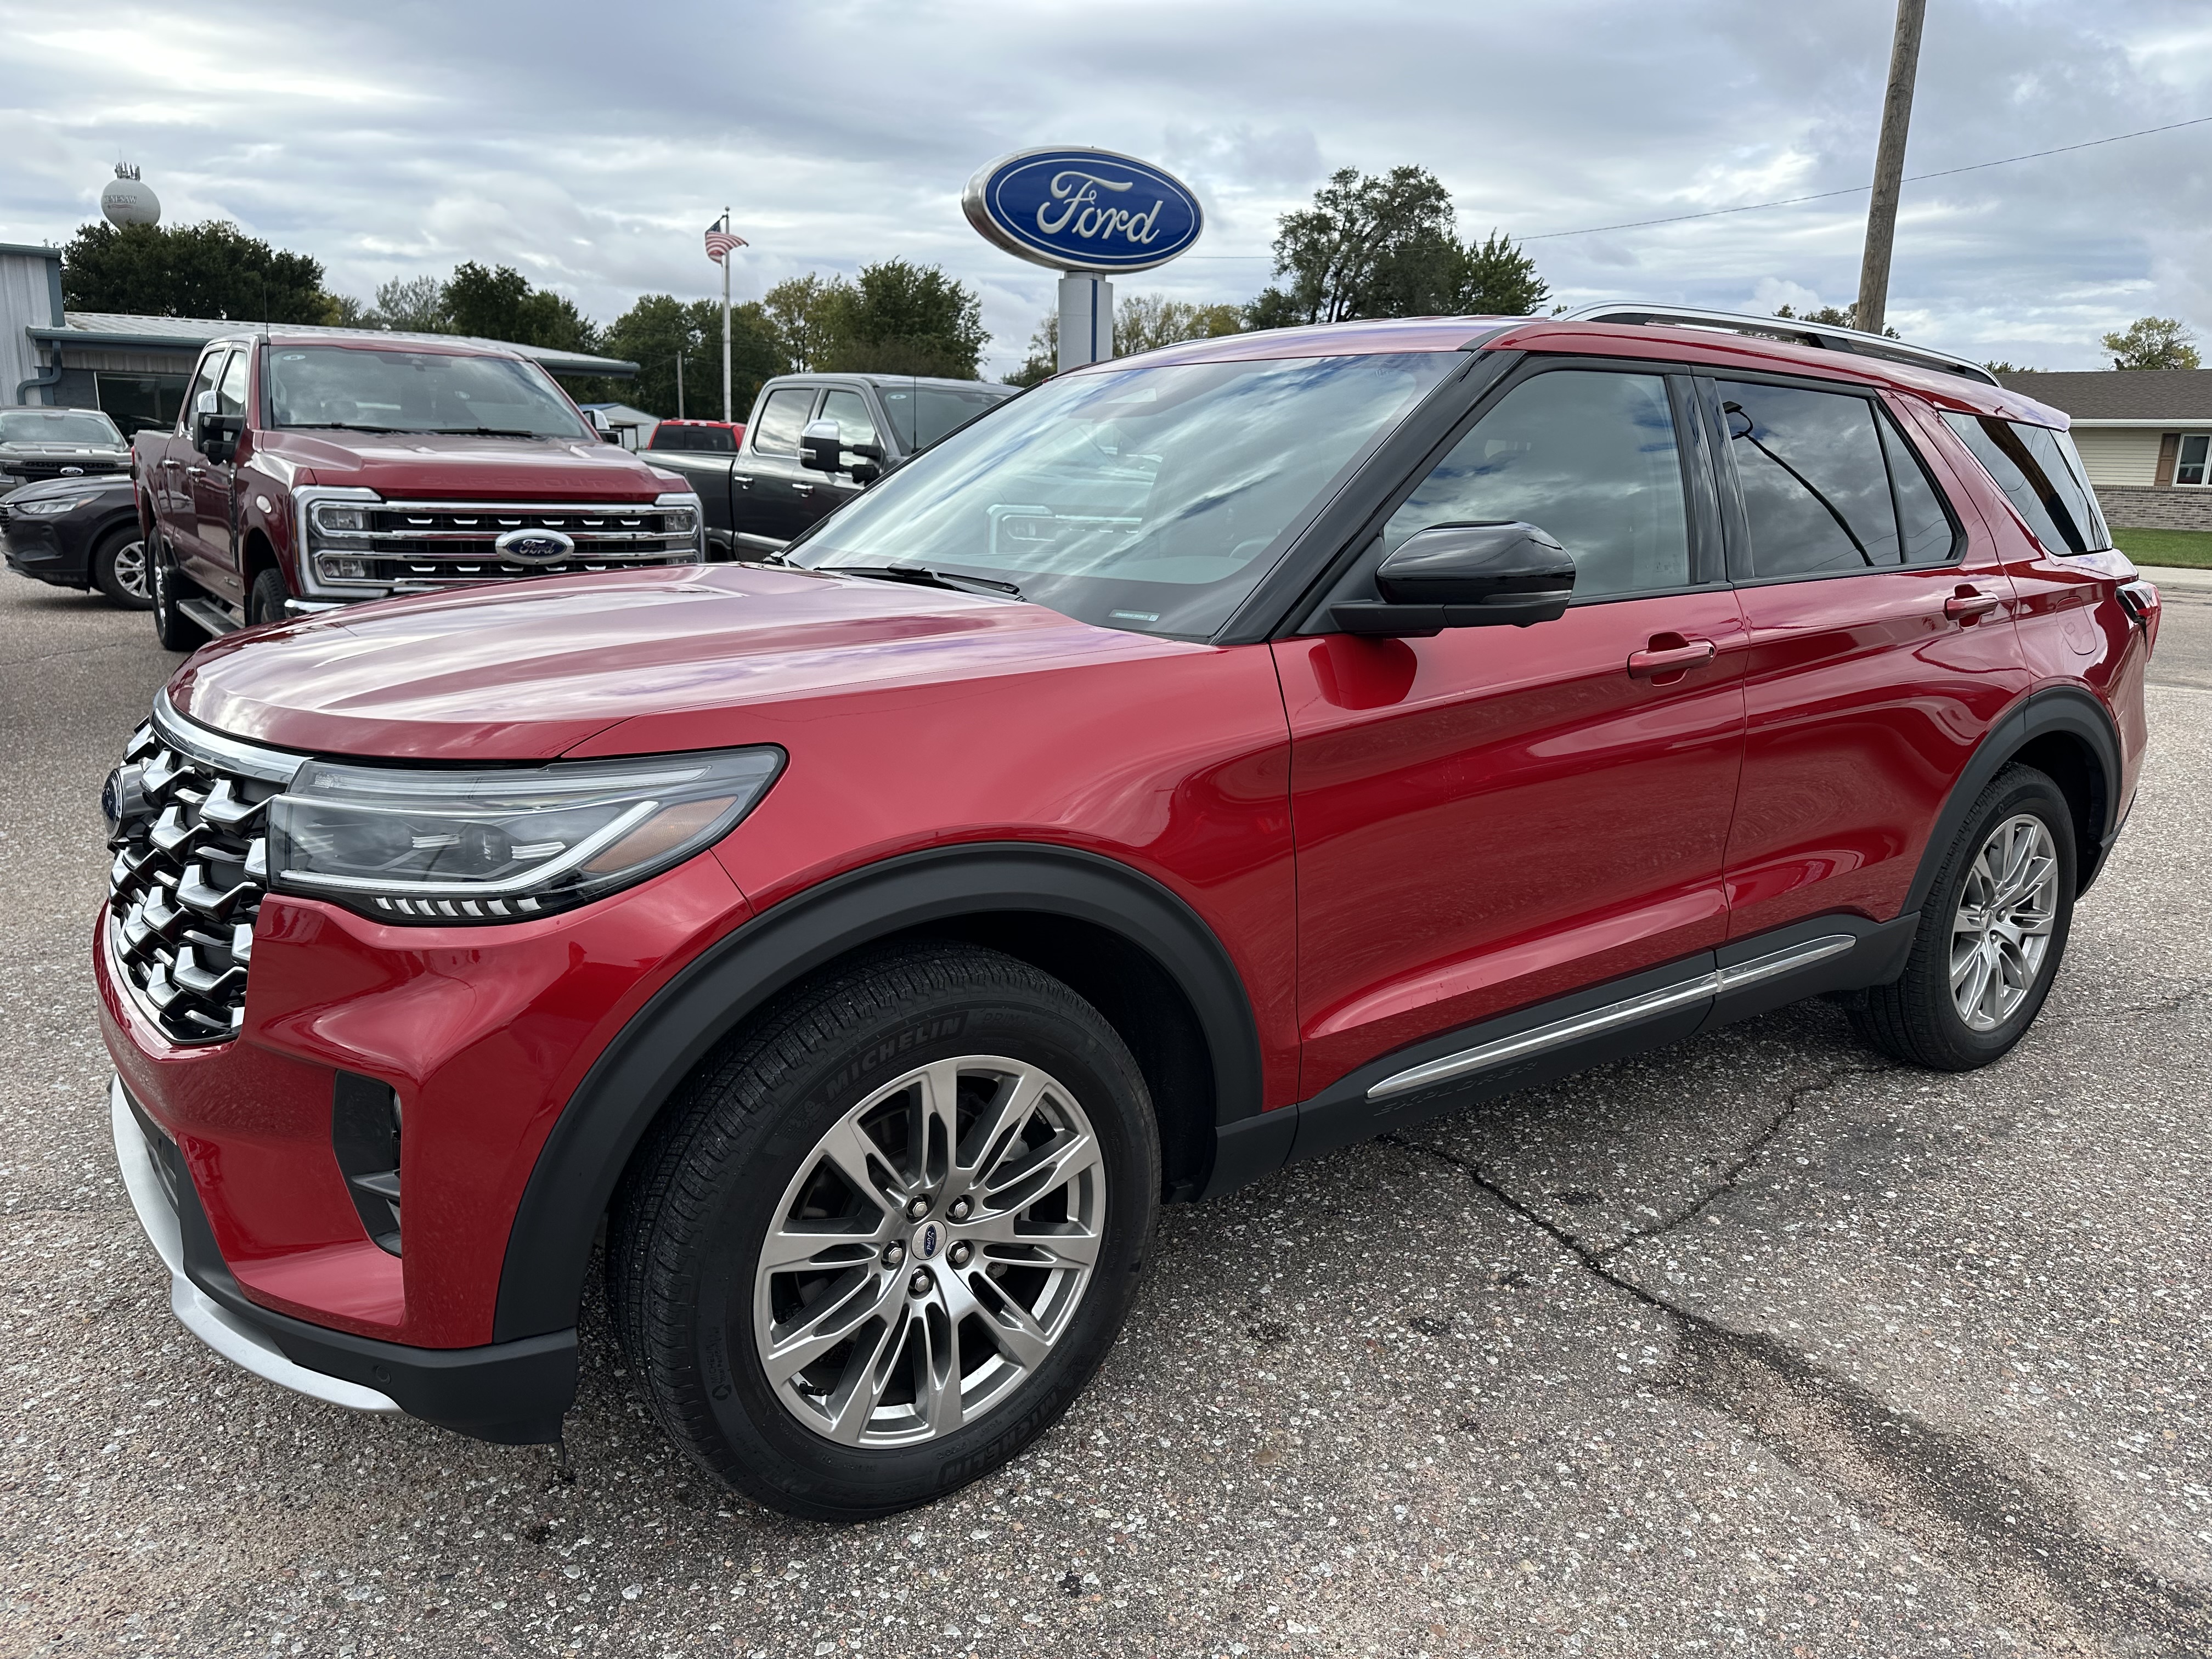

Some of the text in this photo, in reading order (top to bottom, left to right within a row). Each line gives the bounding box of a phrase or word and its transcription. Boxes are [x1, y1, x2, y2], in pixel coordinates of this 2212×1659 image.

[1037, 171, 1163, 245] Ford
[544, 477, 623, 488] DUTY
[519, 538, 555, 555] Ford
[826, 1017, 961, 1102] MICHELIN
[1373, 1061, 1538, 1116] EXPLORER
[927, 1231, 935, 1251] Ford
[944, 1391, 1059, 1483] MICHELIN
